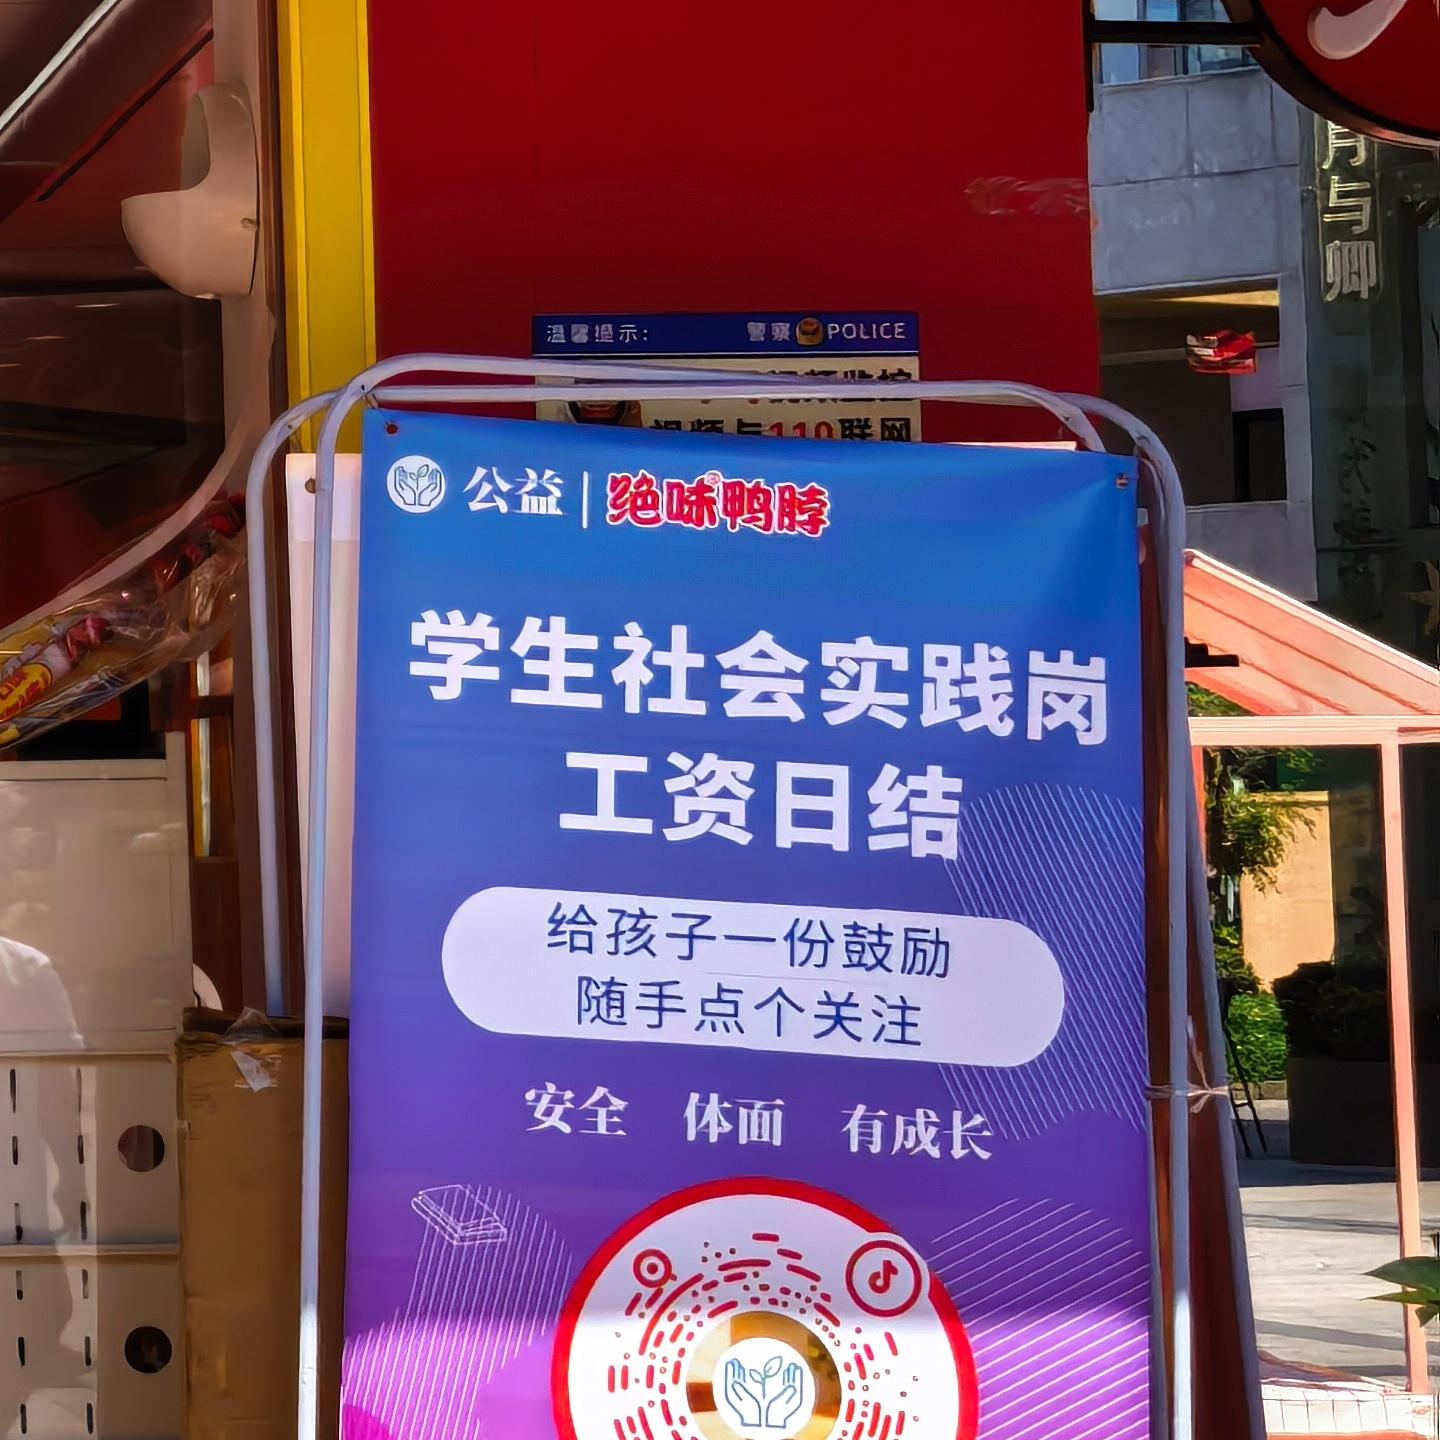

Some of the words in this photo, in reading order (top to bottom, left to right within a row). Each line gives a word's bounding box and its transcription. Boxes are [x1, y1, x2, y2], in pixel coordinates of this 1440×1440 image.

[827, 321, 906, 342] POLICE
[464, 465, 563, 516] 公益
[606, 470, 829, 537] 绝味鸭脖
[409, 610, 1108, 745] 学生社会实践岗
[559, 752, 963, 861] 工资日结
[546, 901, 950, 980] 给孩子一份鼓励
[576, 975, 923, 1047] 随手点个关注
[525, 1082, 627, 1138] 安全
[682, 1092, 784, 1146] 体面
[841, 1103, 994, 1162] 有成长
